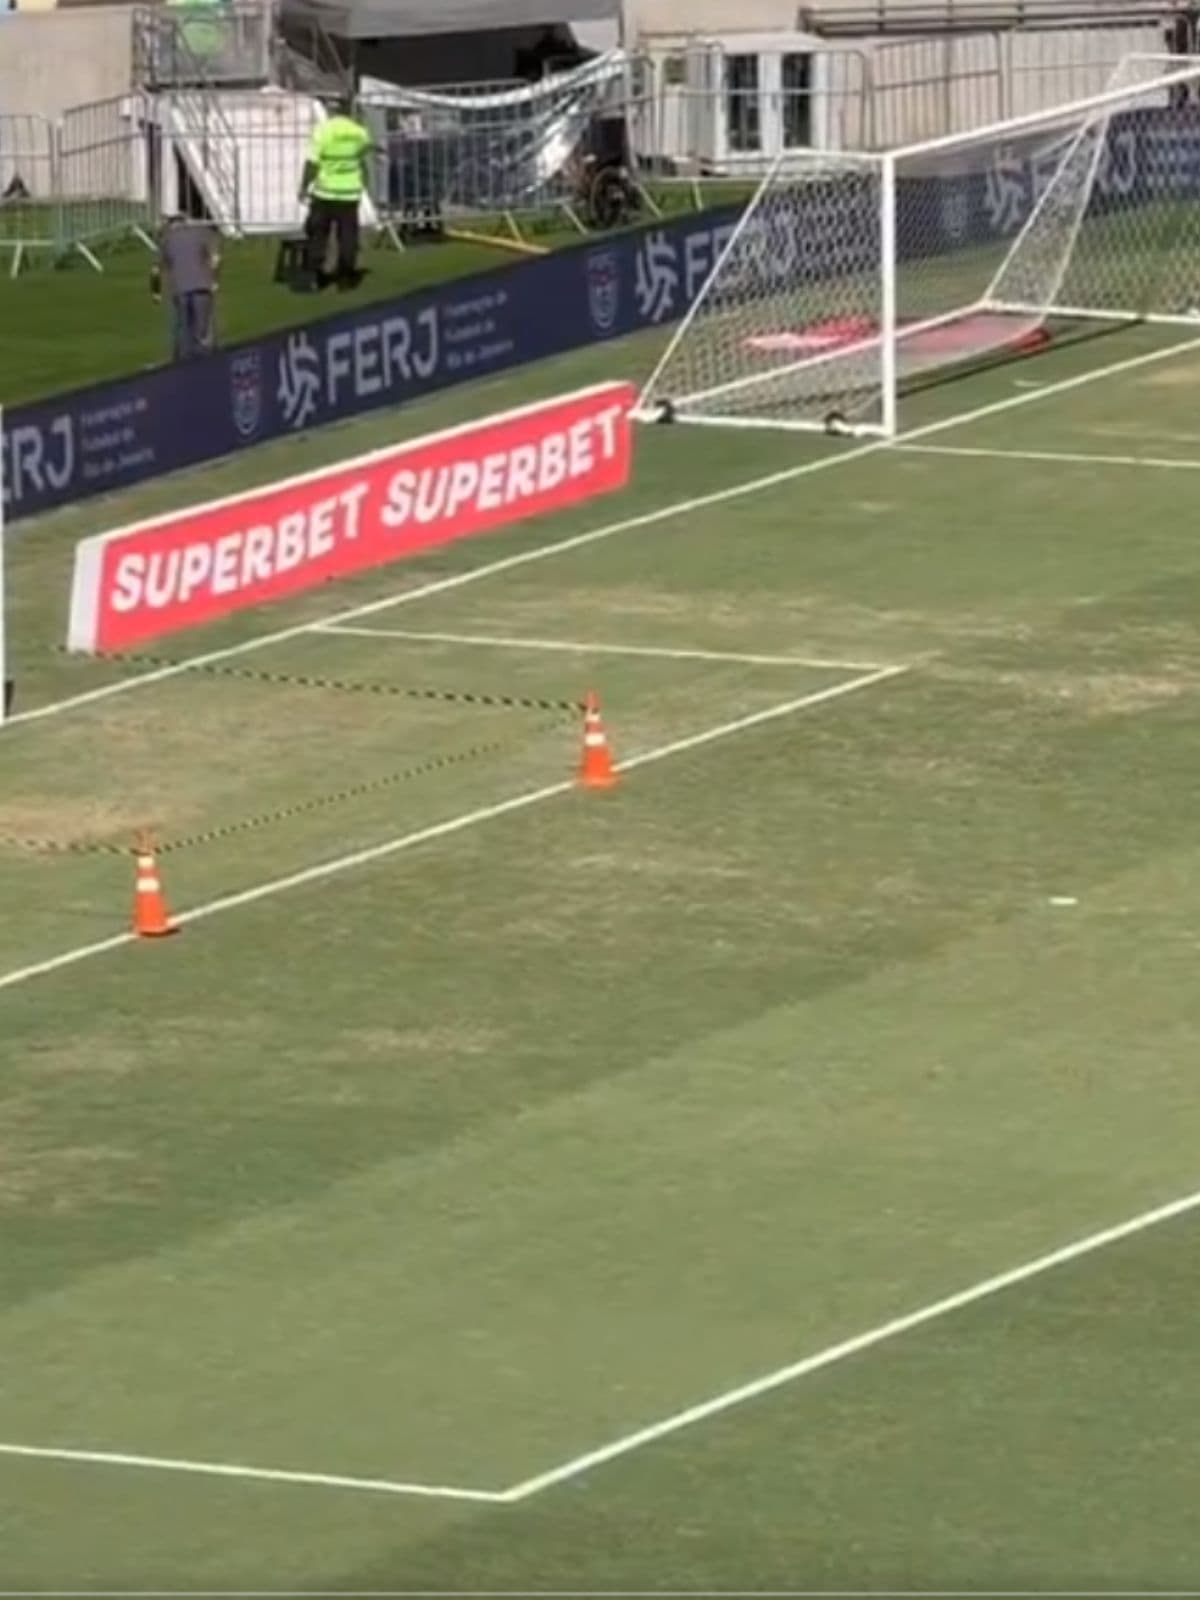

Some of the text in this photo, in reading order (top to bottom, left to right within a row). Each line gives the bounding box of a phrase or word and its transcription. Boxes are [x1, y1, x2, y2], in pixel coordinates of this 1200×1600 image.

[326, 306, 439, 406] FERJ
[111, 403, 623, 613] SUPERBET SUPERBET
